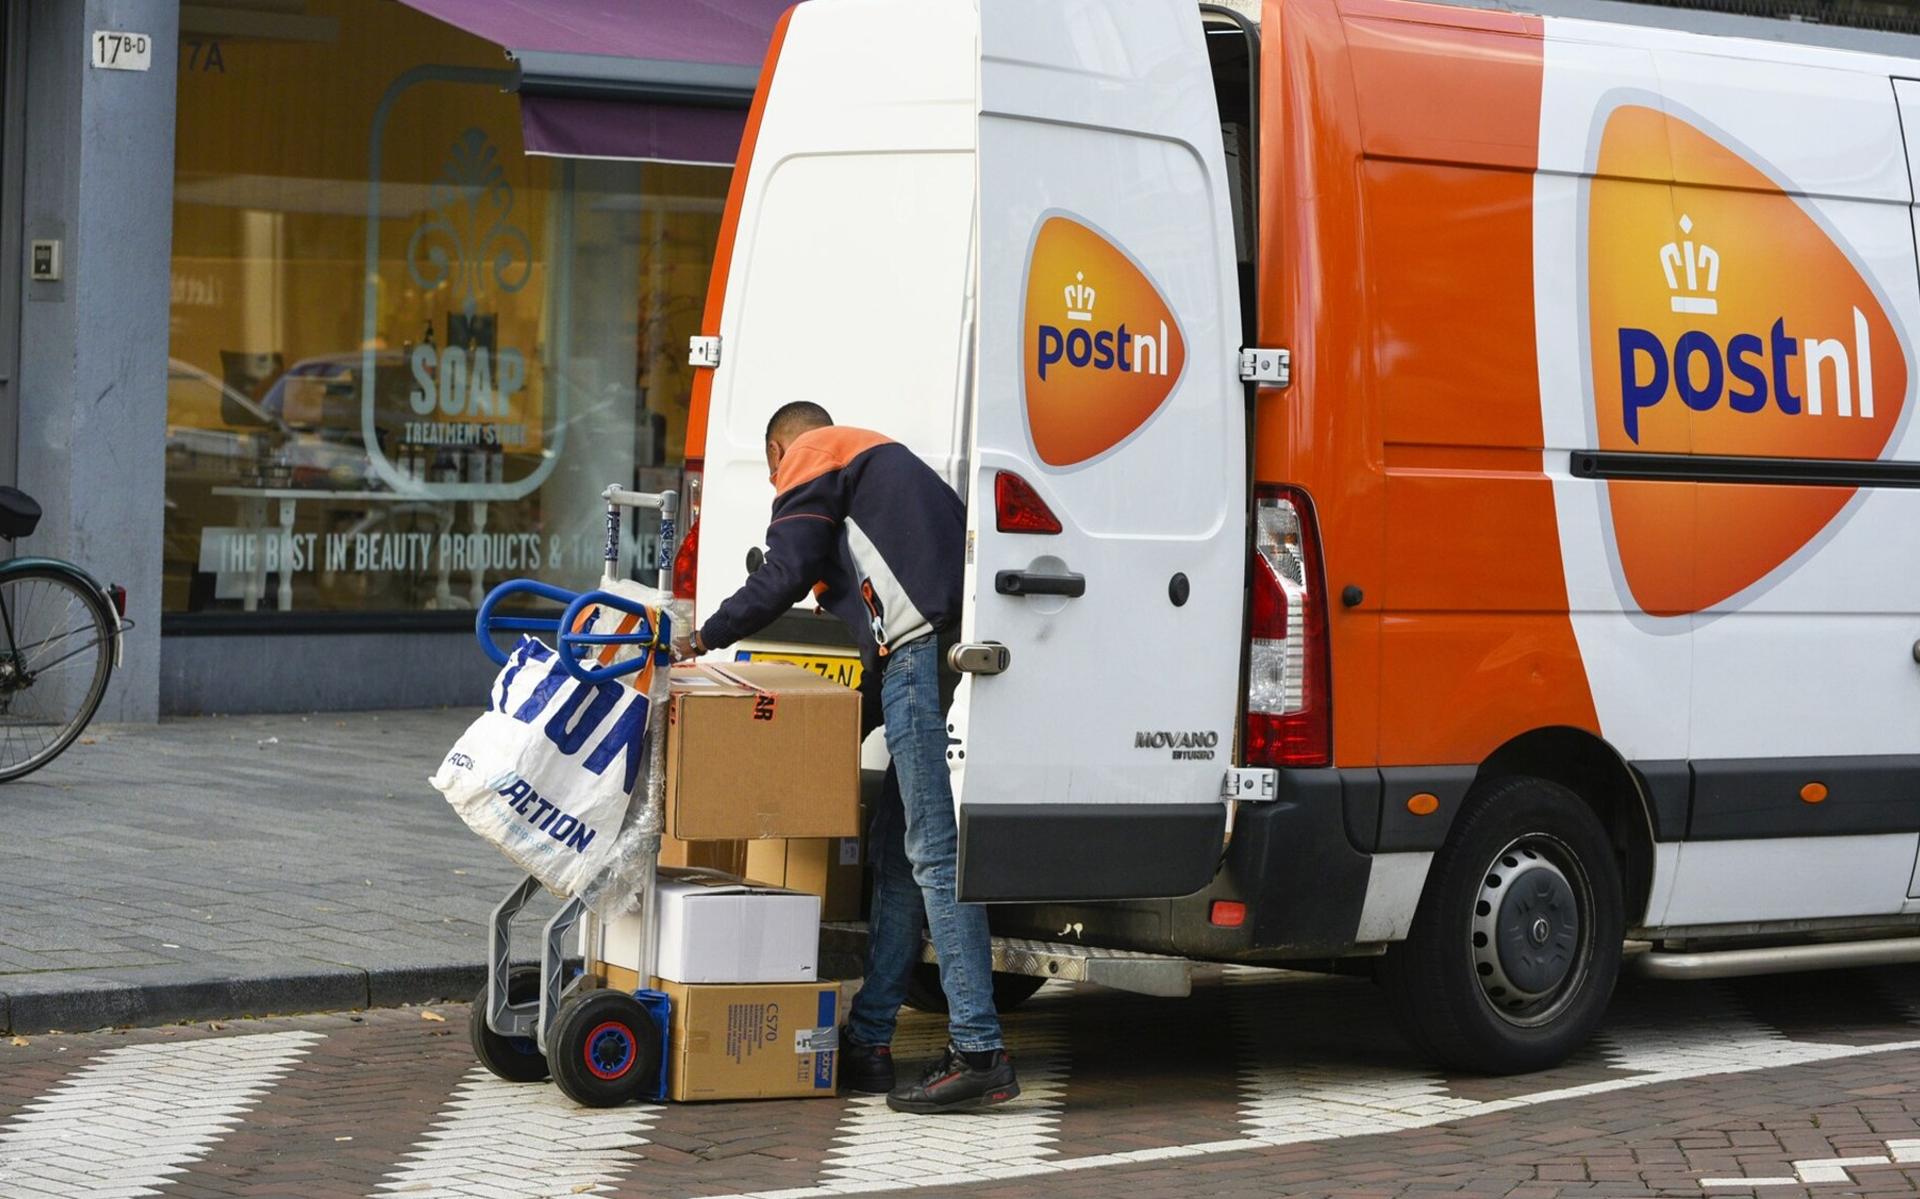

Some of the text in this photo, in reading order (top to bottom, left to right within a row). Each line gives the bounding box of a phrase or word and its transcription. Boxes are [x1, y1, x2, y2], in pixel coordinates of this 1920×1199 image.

[1038, 319, 1168, 382] postnl
[1618, 305, 1875, 446] postnl
[410, 343, 525, 417] SOAP
[405, 422, 482, 444] TREATMENT
[220, 533, 257, 571] THE
[325, 533, 346, 571] IN
[355, 533, 431, 571] BEAUTY
[439, 533, 541, 571] PRODUCTS
[549, 534, 562, 570] &
[1134, 731, 1219, 748] MOVANO
[499, 779, 596, 854] ACTION
[765, 1003, 779, 1042] CS70
